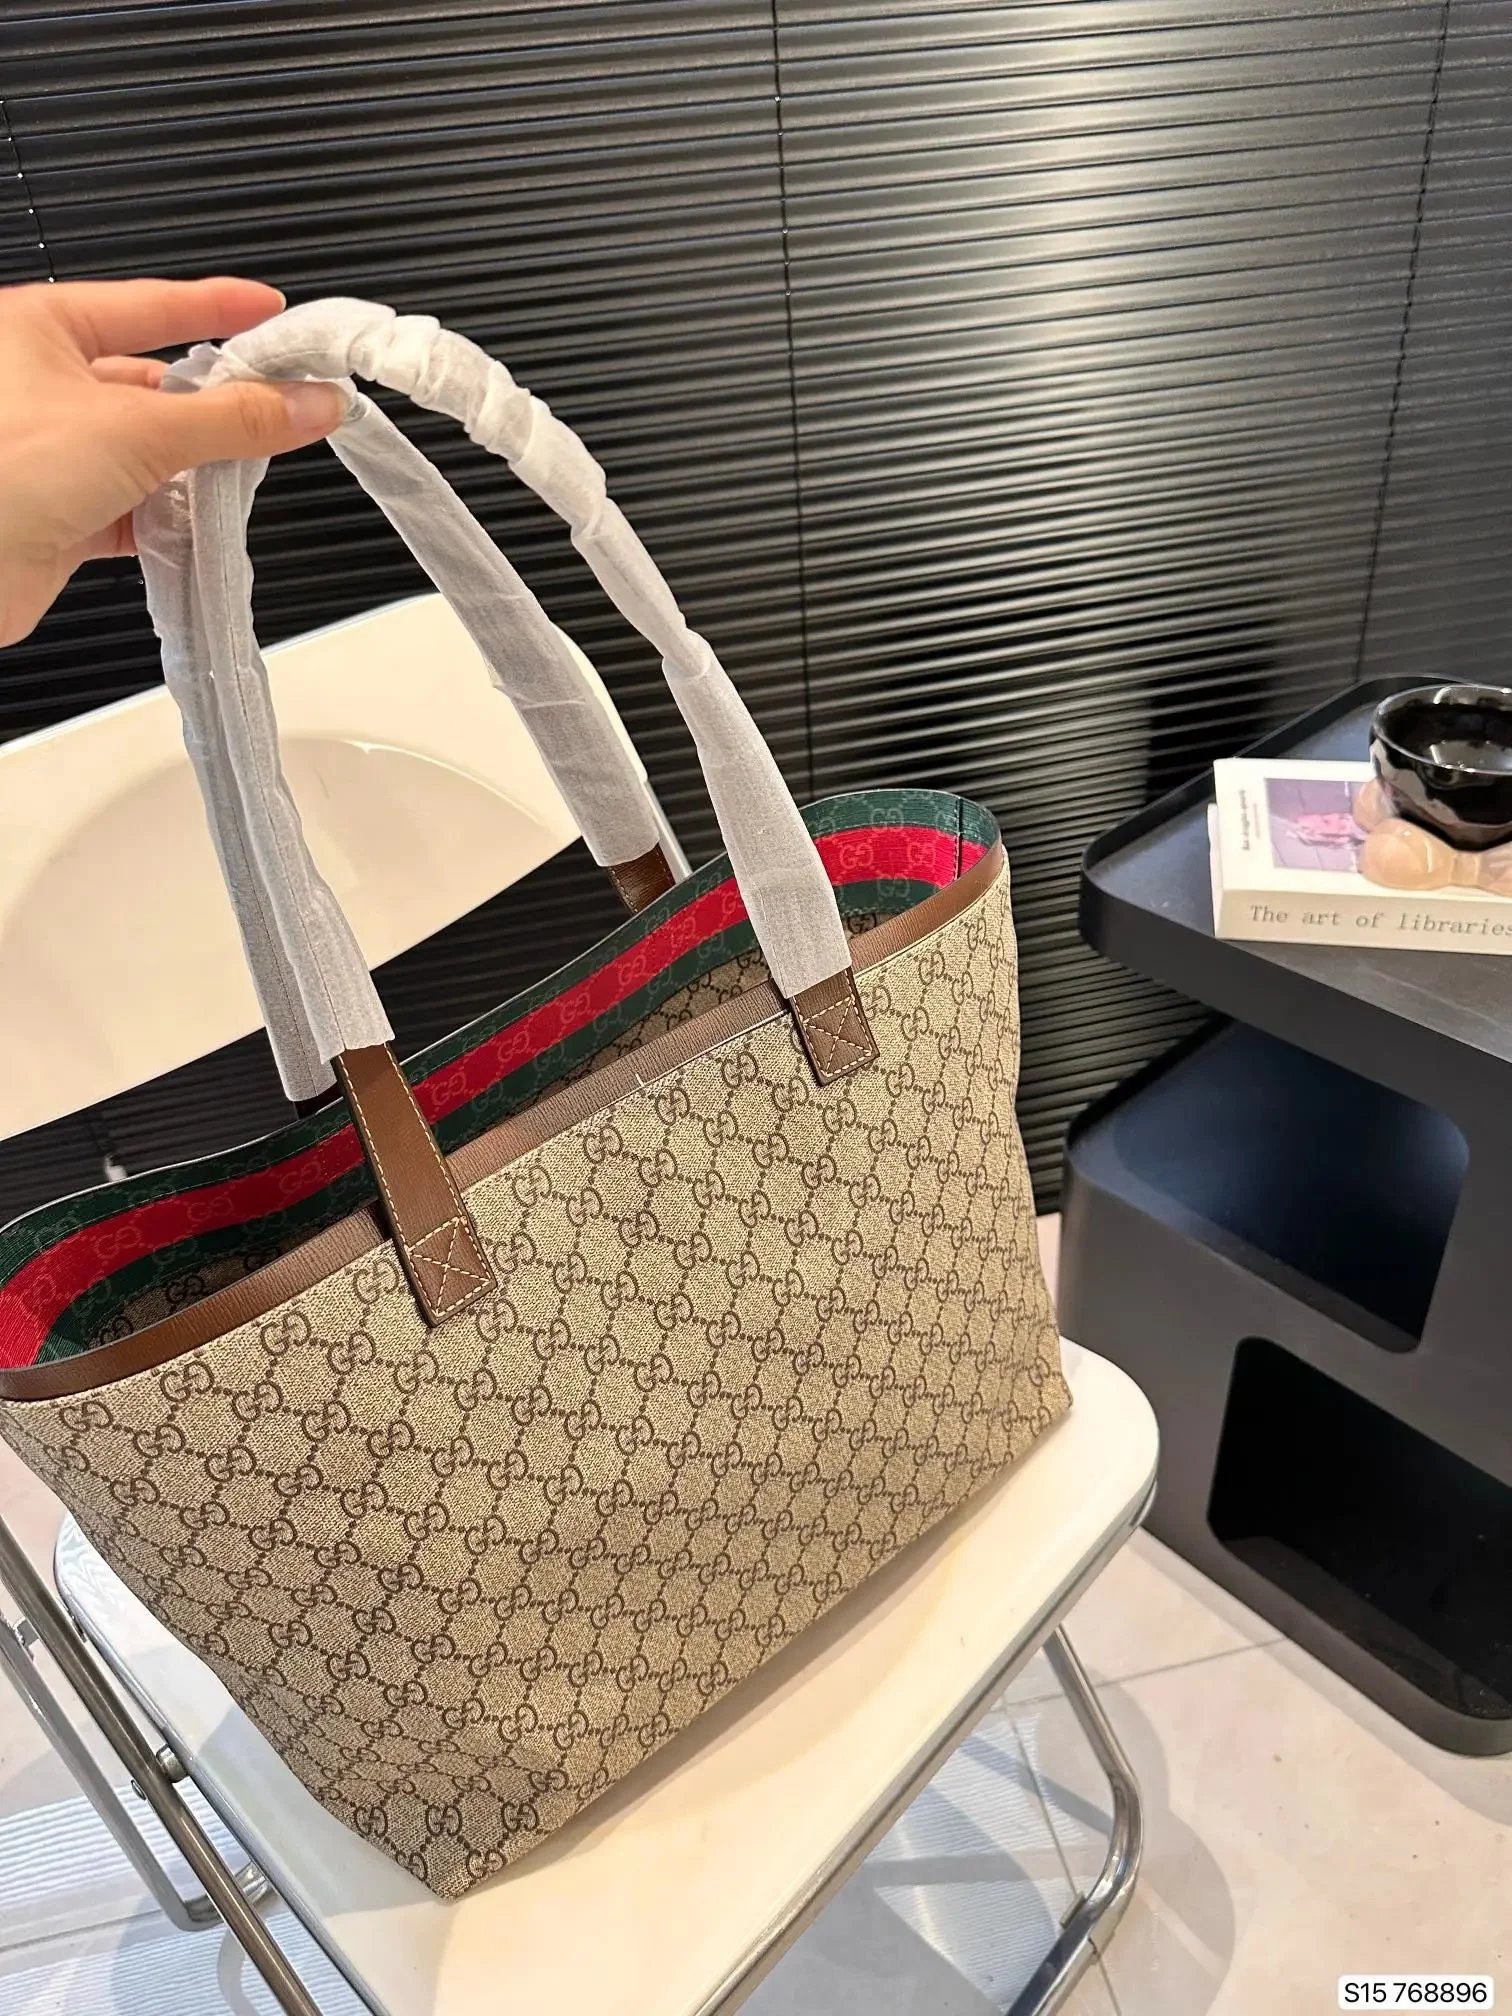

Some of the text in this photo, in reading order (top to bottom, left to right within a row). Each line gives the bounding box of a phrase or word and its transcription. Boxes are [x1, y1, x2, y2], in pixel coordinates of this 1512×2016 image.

[1249, 904, 1512, 937] The art of libraries
